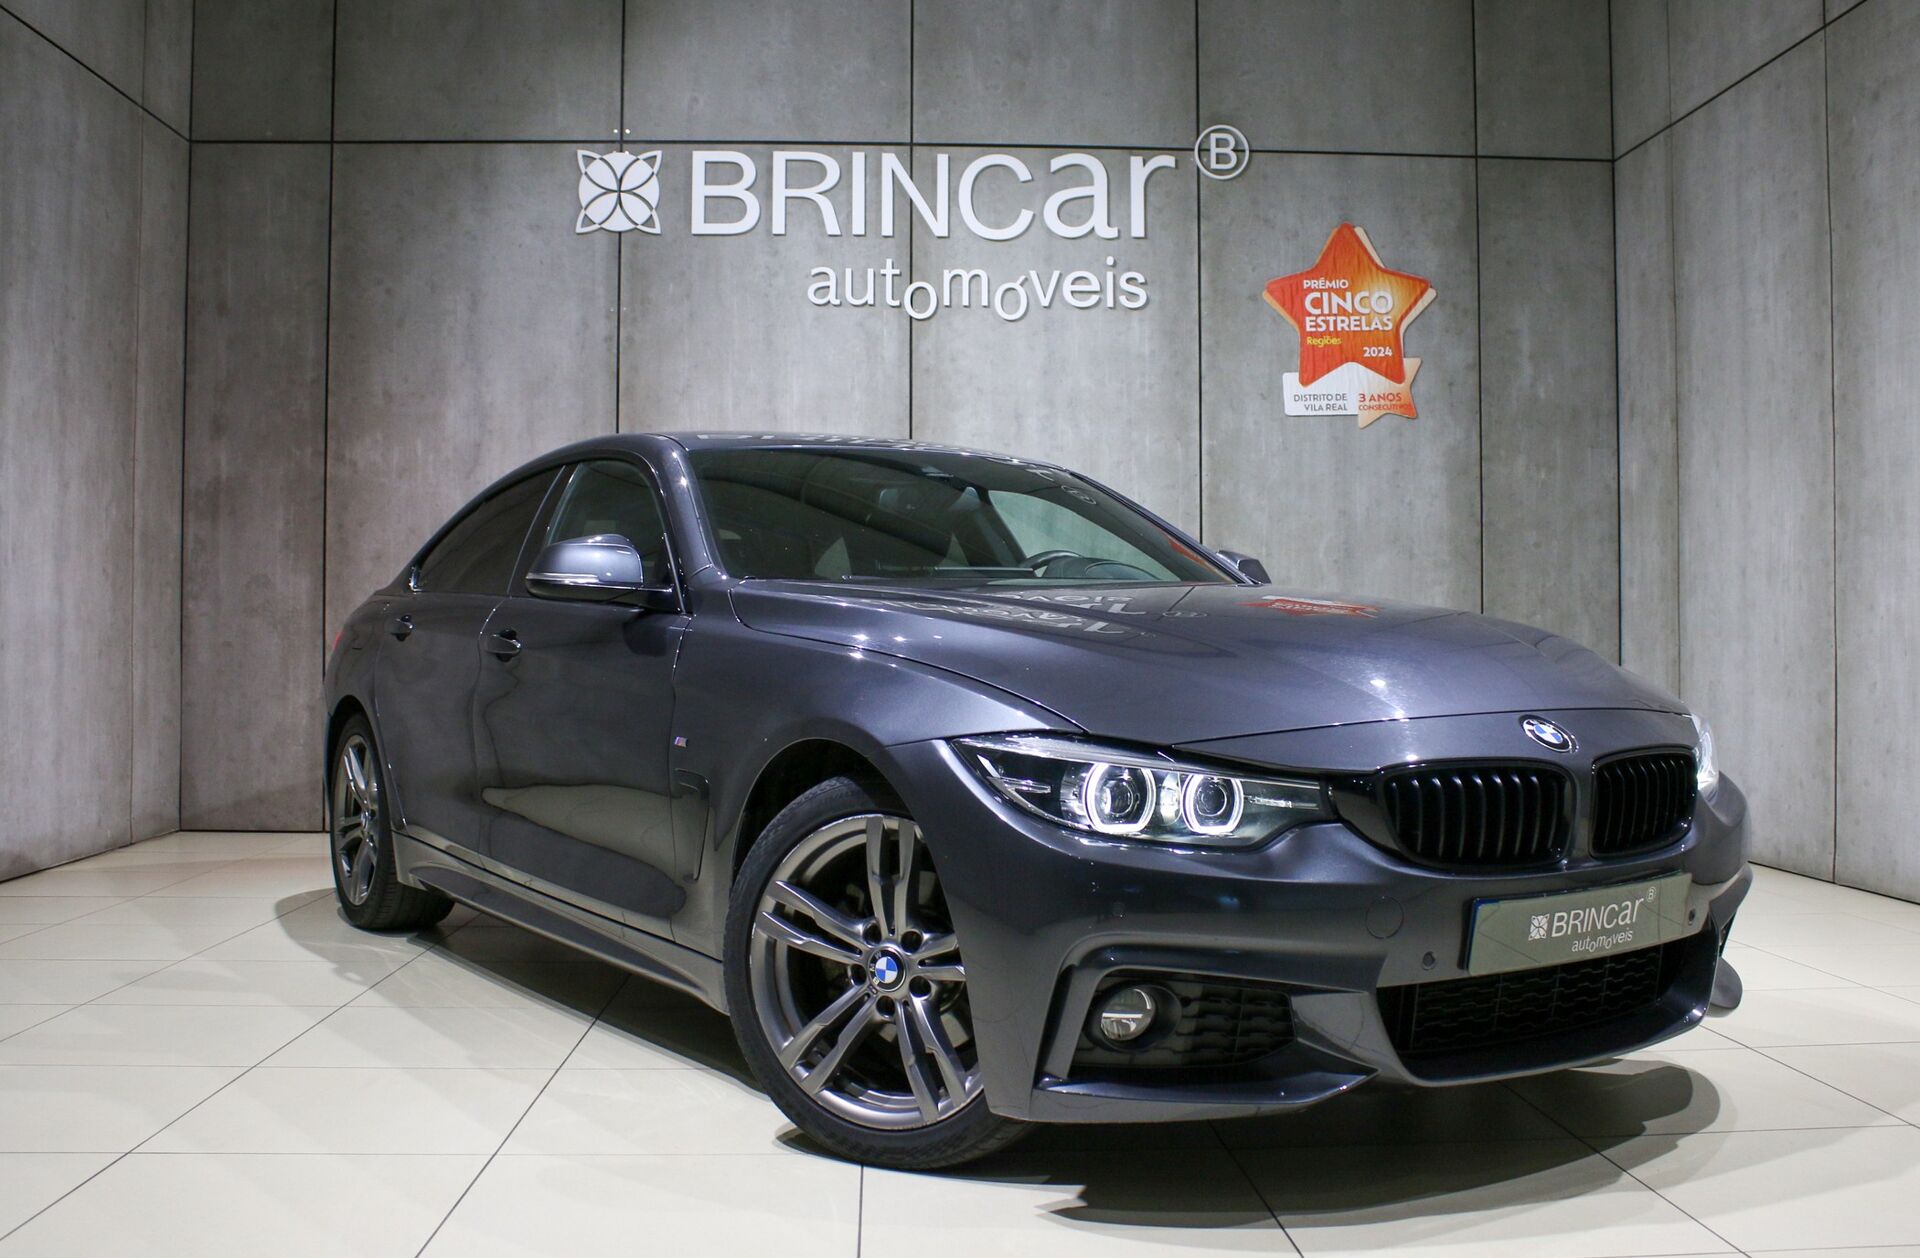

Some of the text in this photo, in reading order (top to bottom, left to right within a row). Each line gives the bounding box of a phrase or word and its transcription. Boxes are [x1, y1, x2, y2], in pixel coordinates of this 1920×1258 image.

[691, 150, 1176, 241] BRINCar
[807, 256, 1148, 321] automóveis
[1303, 277, 1349, 289] PRÉMIO
[1304, 291, 1394, 315] CINCO
[1305, 316, 1393, 332] ESTRELAS
[1306, 336, 1342, 348] Regiões
[1363, 347, 1393, 357] 2024
[1293, 393, 1348, 402] DISTRITO DE
[1359, 392, 1402, 402] 3 ANOS
[1325, 403, 1348, 411] REAL
[1551, 898, 1644, 938] BRINCar
